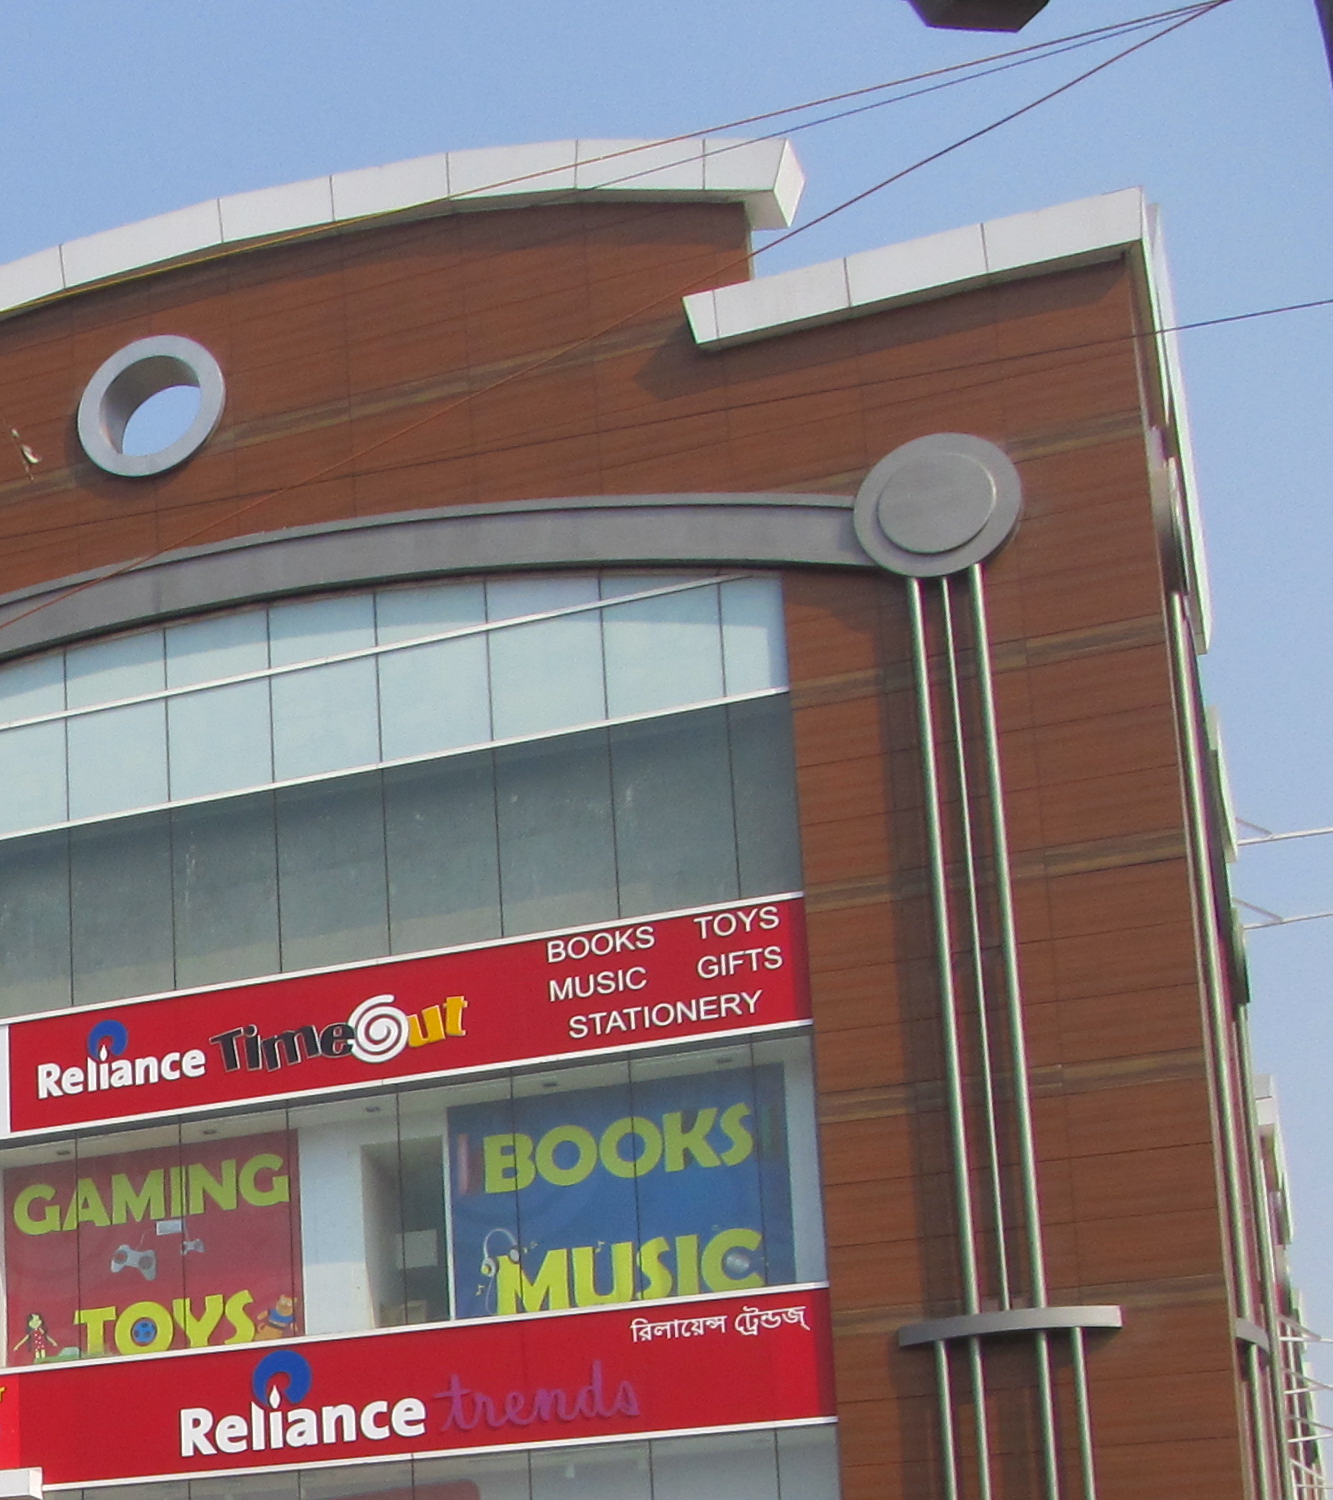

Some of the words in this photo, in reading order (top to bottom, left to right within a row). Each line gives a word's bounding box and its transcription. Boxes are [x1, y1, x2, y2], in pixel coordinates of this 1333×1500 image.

[546, 925, 656, 964] BOOKS
[694, 905, 781, 941] TOYS
[548, 966, 648, 1002] MUSIC
[697, 945, 784, 980] GIFTS
[567, 990, 763, 1040] STATIONERY
[37, 1045, 207, 1099] Reliance
[483, 1101, 754, 1194] BOOKS
[14, 1154, 291, 1236] GAMING
[497, 1228, 766, 1315] MUSIC
[74, 1290, 256, 1356] TOYS
[180, 1386, 427, 1458] Reliance
[435, 1361, 641, 1432] trends
